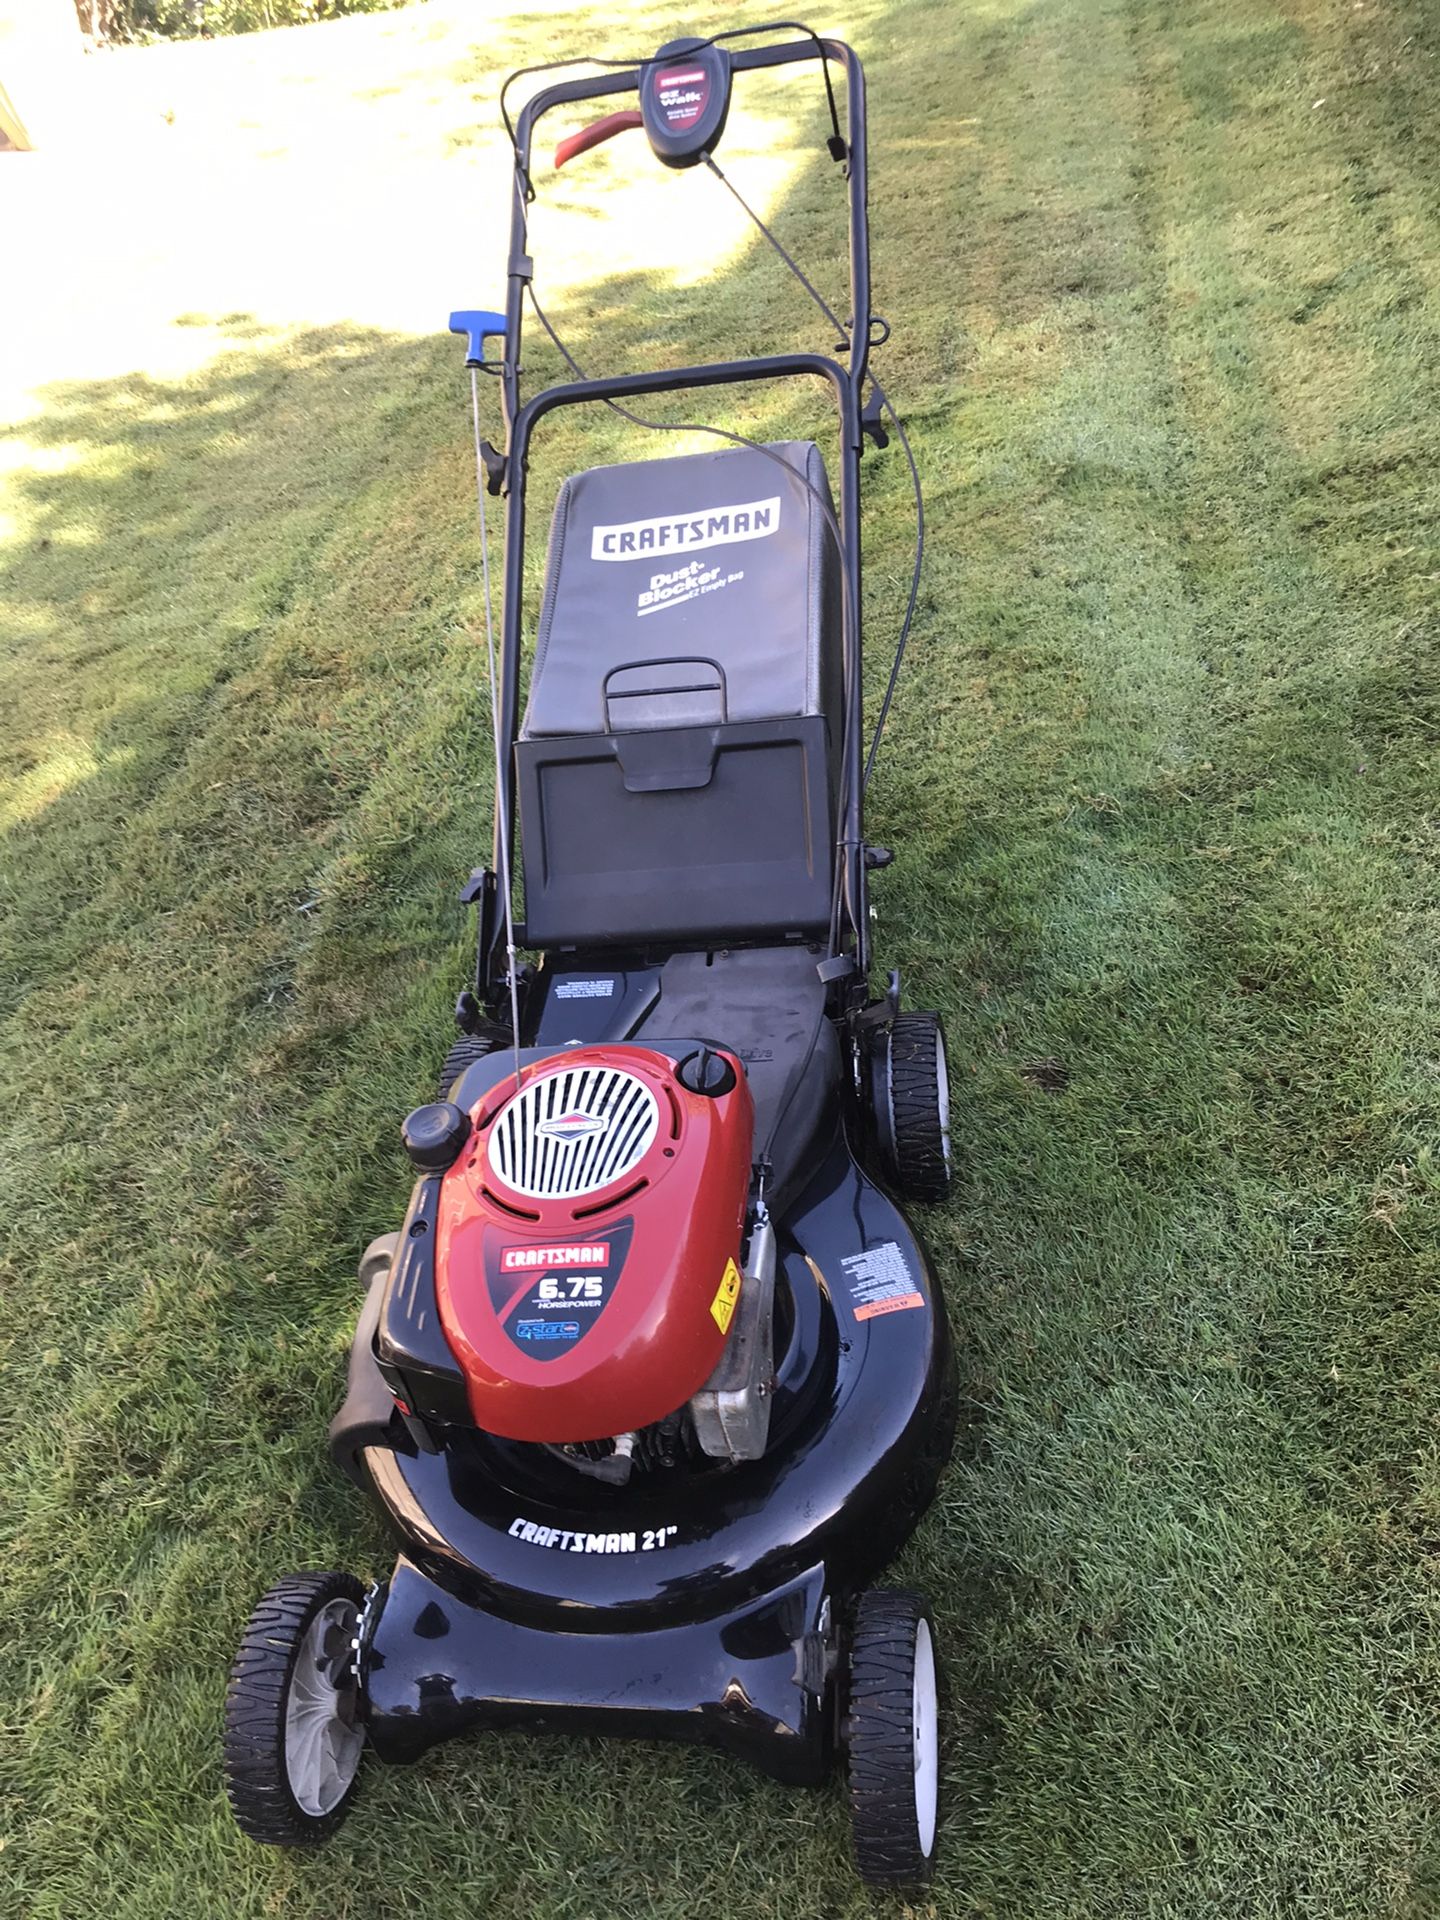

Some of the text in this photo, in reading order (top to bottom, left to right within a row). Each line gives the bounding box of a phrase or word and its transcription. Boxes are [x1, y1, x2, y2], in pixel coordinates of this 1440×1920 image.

[603, 508, 770, 553] CRAFTSMAN
[638, 567, 720, 607] Blocker
[650, 561, 705, 590] Dust-
[689, 588, 700, 598] EZ
[505, 1247, 604, 1267] CRAFTSMAN
[539, 1276, 603, 1299] 6.75
[538, 1300, 602, 1309] HORSEPOWER
[508, 1517, 678, 1554] CRAFTSMAN 21"
